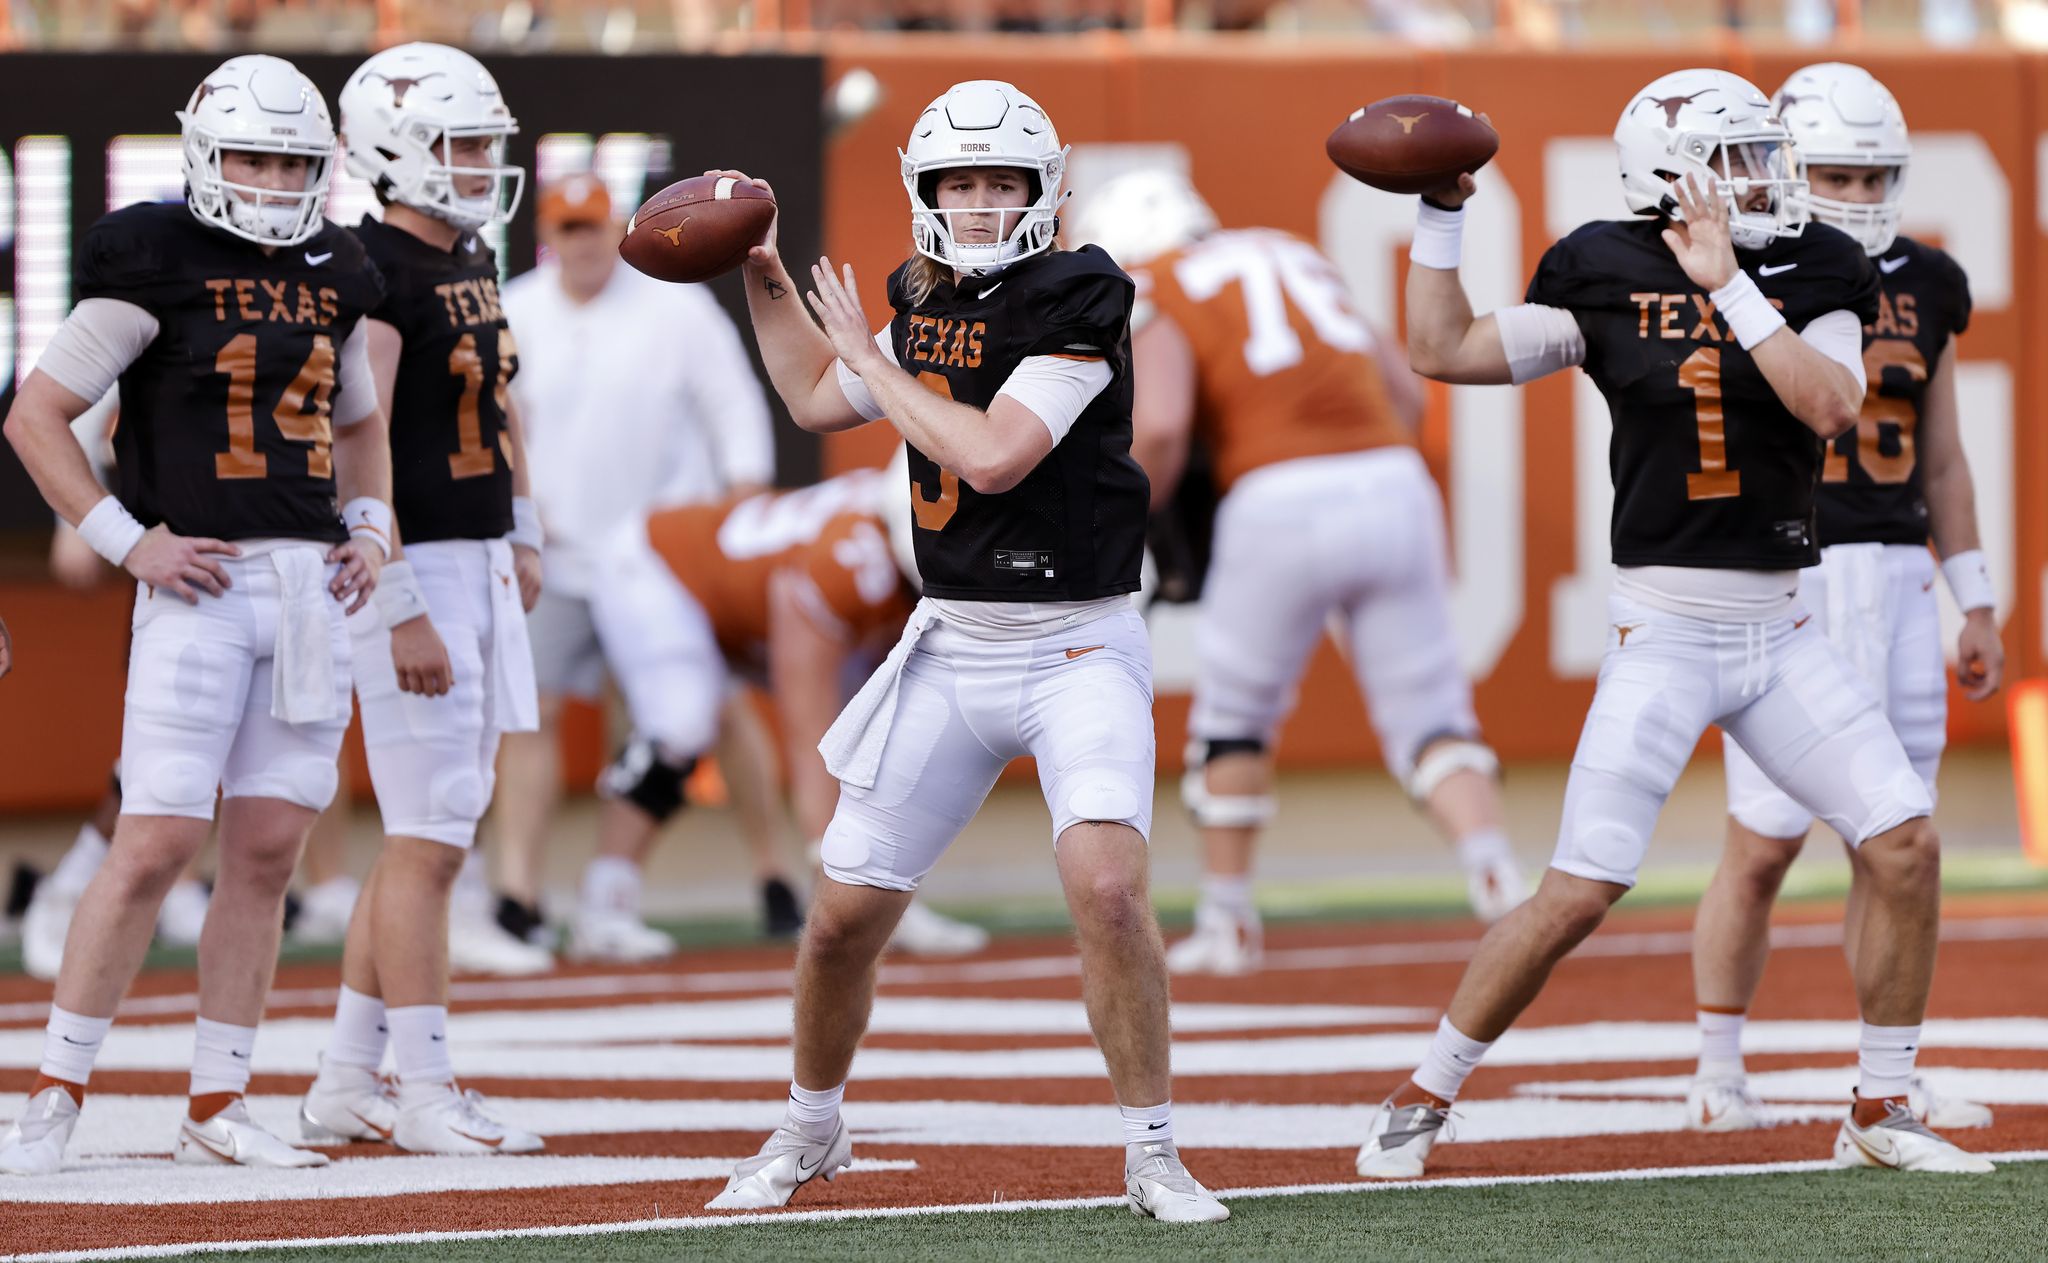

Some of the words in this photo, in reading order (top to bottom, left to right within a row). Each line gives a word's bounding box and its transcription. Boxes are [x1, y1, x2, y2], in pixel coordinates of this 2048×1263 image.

[960, 143, 991, 153] HORNS
[205, 279, 339, 327] TEXAS
[1629, 293, 1784, 342] TEX
[905, 314, 986, 368] TEXAS
[214, 333, 336, 480] 14
[1678, 346, 1742, 501] 1
[1040, 555, 1049, 564] M
